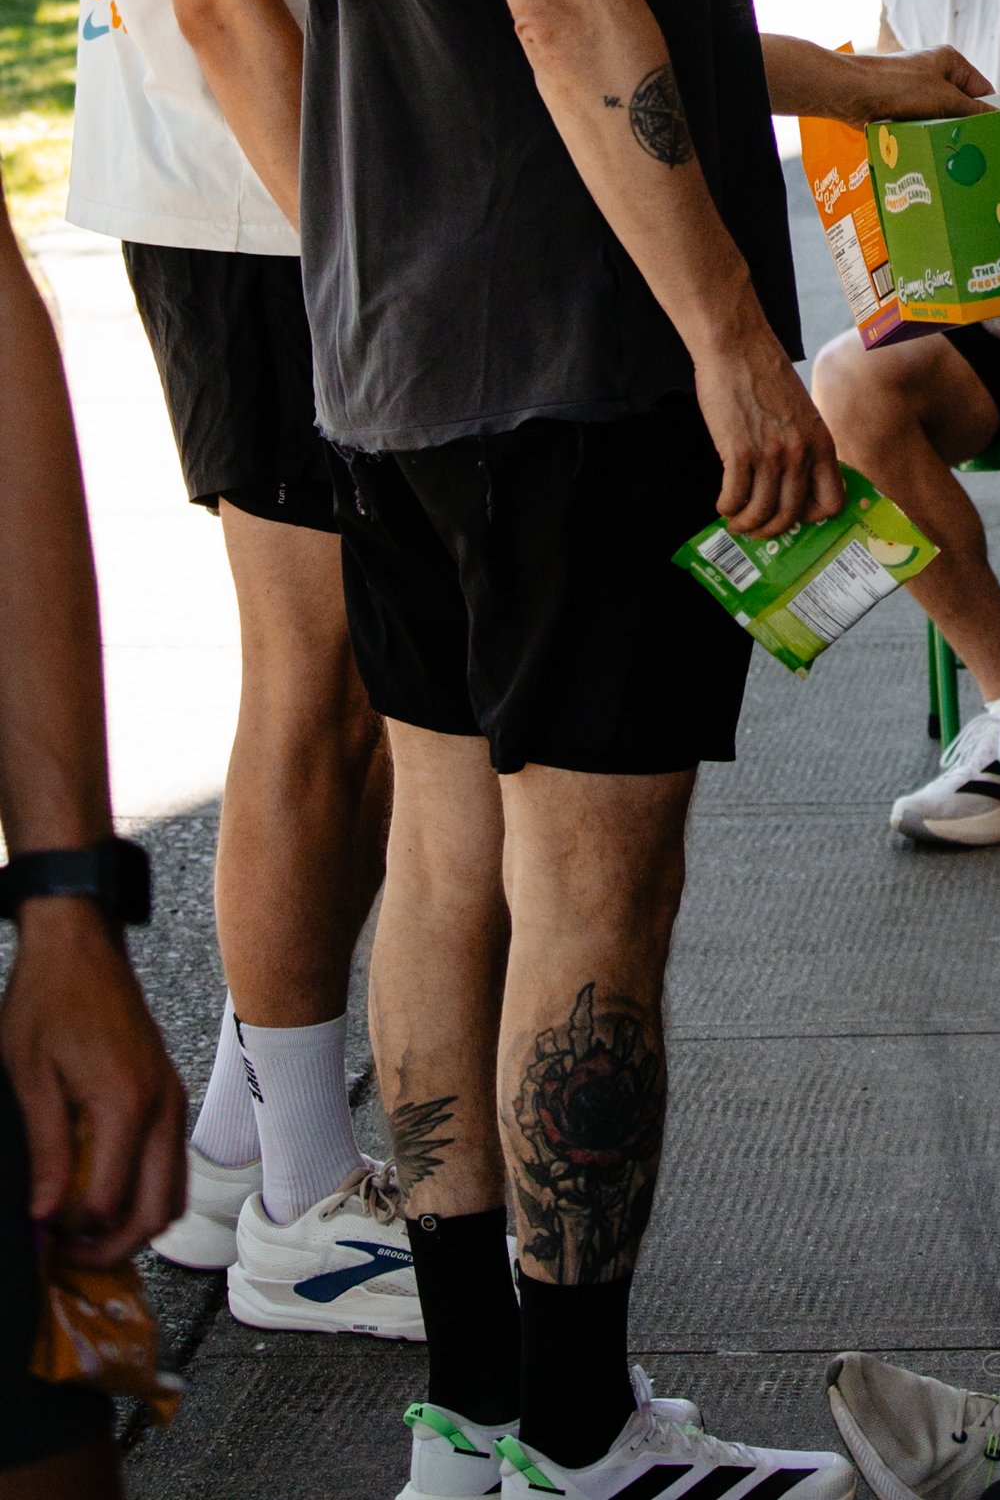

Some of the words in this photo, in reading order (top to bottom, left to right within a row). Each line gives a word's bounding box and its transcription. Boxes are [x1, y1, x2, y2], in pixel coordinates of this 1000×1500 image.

[887, 185, 897, 195] THE
[898, 175, 924, 192] ORIGINAL
[908, 188, 930, 200] CANDY!
[974, 264, 995, 278] THE
[898, 275, 926, 305] Gummy
[925, 269, 953, 297] Gainz
[377, 1248, 414, 1263] BROOKS
